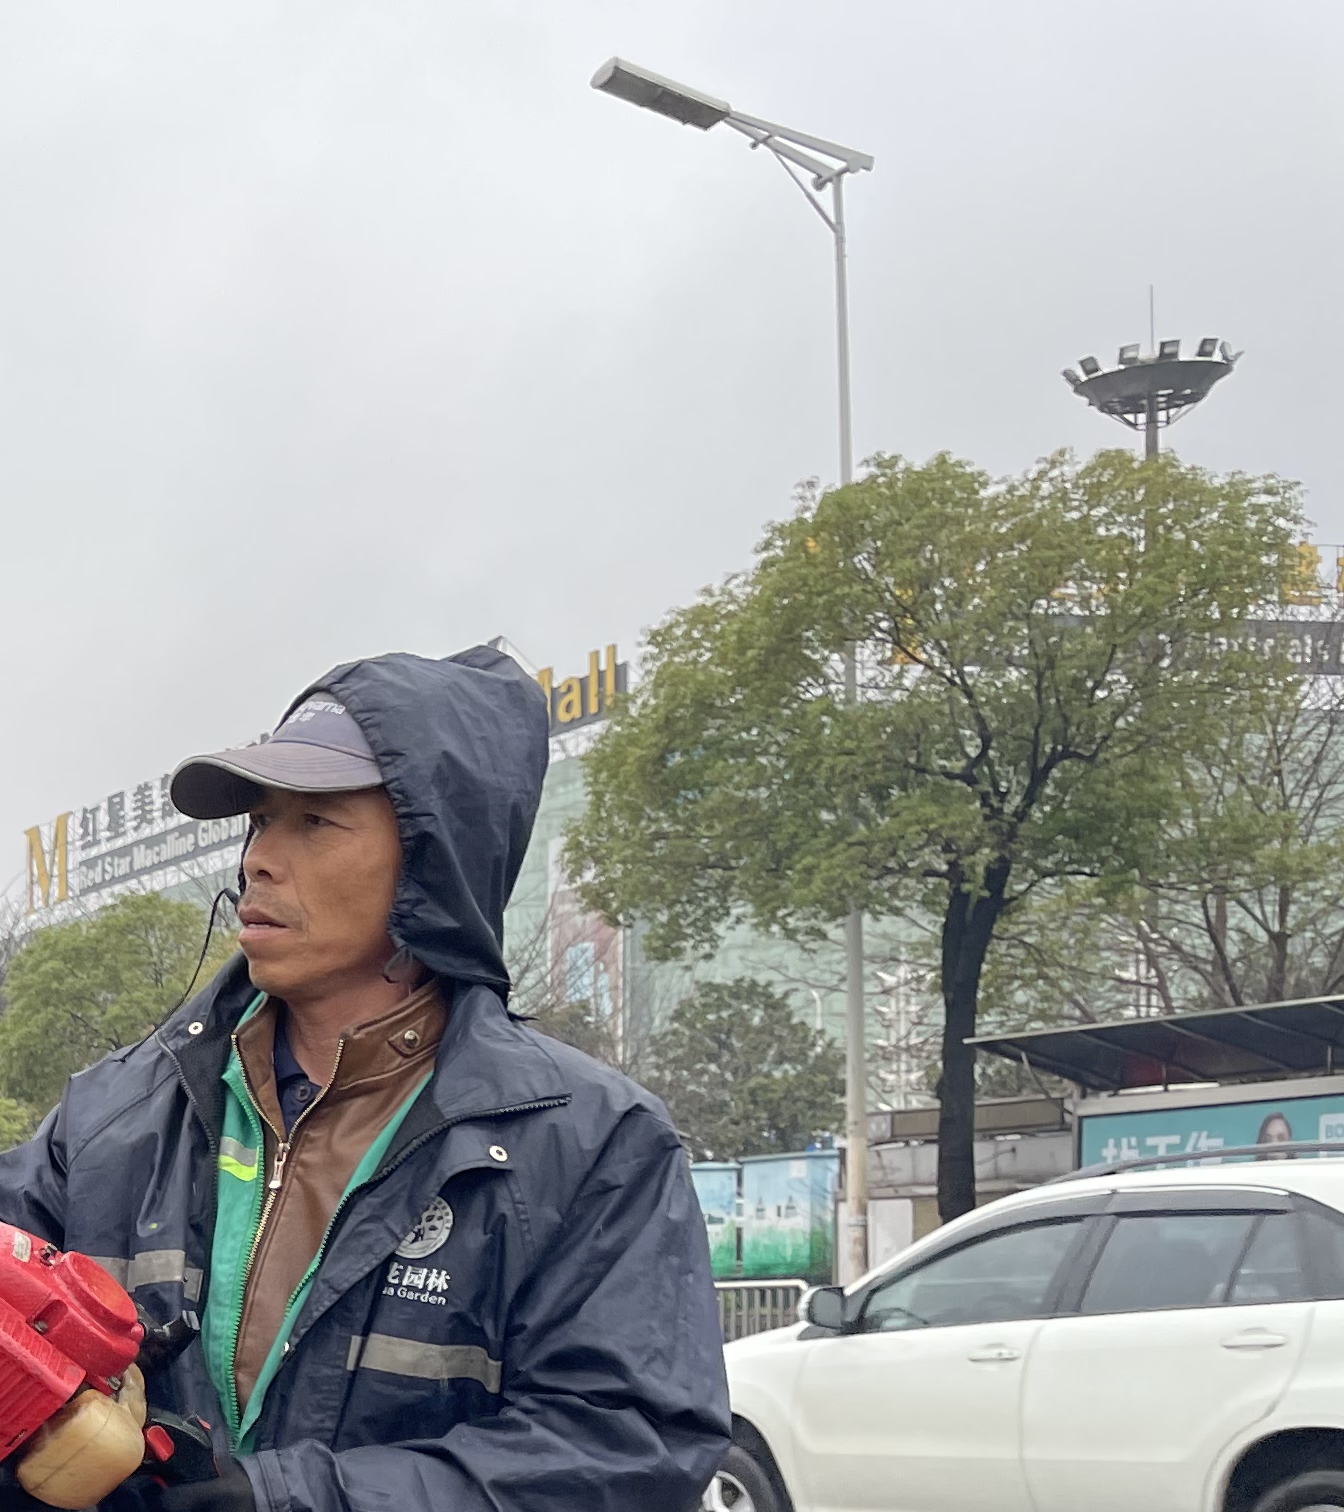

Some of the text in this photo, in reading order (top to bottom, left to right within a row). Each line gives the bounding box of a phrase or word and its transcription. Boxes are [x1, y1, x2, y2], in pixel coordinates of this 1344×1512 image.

[25, 811, 72, 915] M
[79, 859, 103, 889] Red
[104, 850, 132, 881] Star
[197, 813, 244, 848] Global
[397, 1286, 447, 1306] Garden
